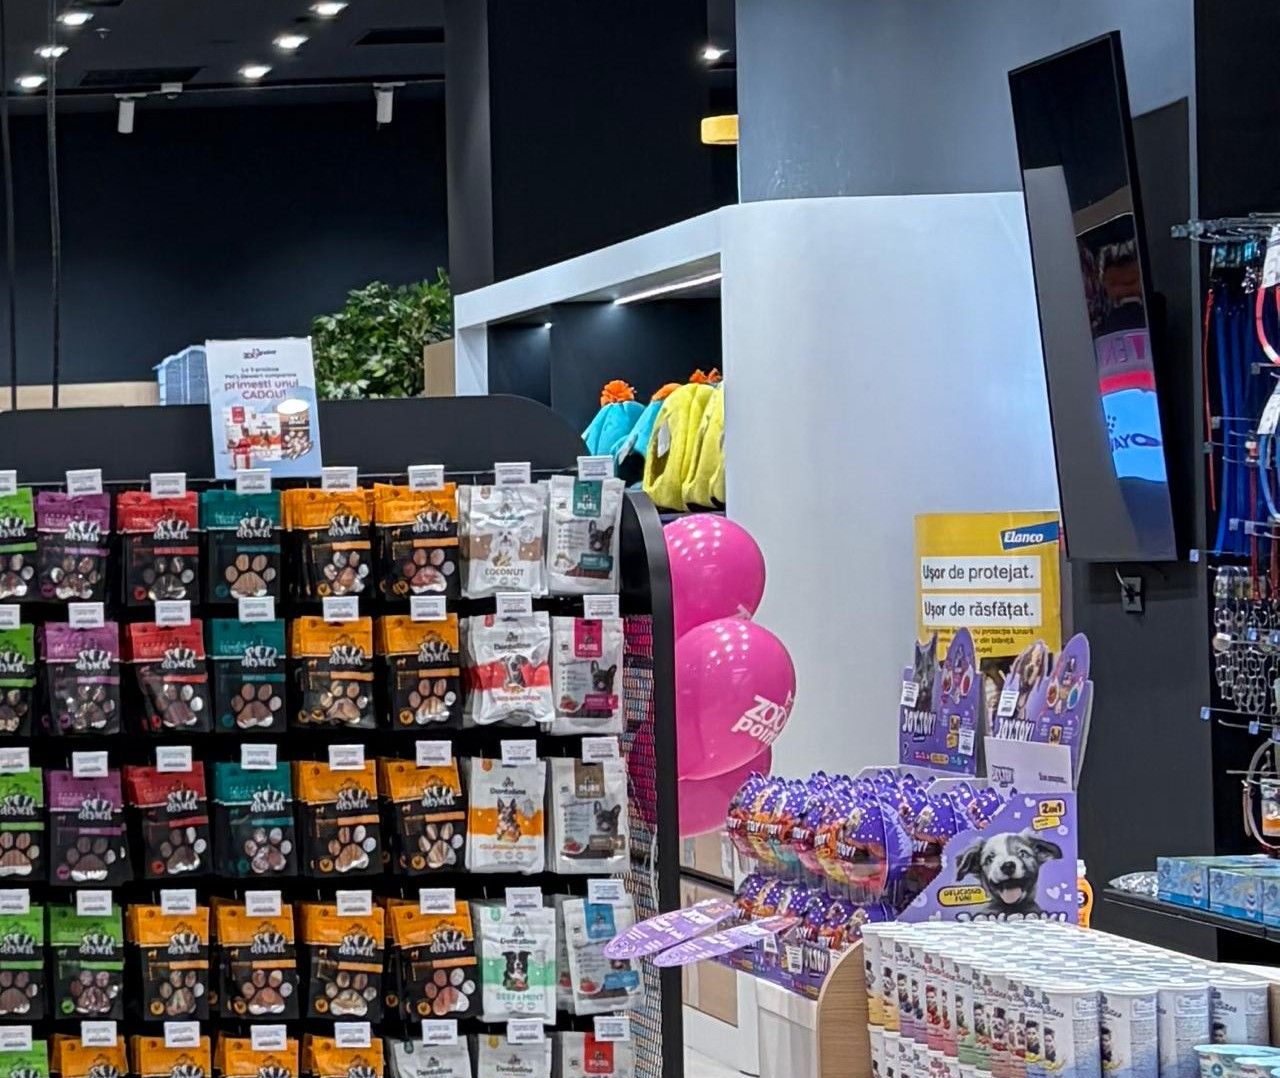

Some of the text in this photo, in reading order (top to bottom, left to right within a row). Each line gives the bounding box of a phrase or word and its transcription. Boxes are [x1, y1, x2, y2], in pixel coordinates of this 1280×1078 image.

[1003, 531, 1044, 543] Elanco
[948, 564, 965, 579] de
[968, 563, 1034, 582] protejat.
[949, 602, 965, 617] de
